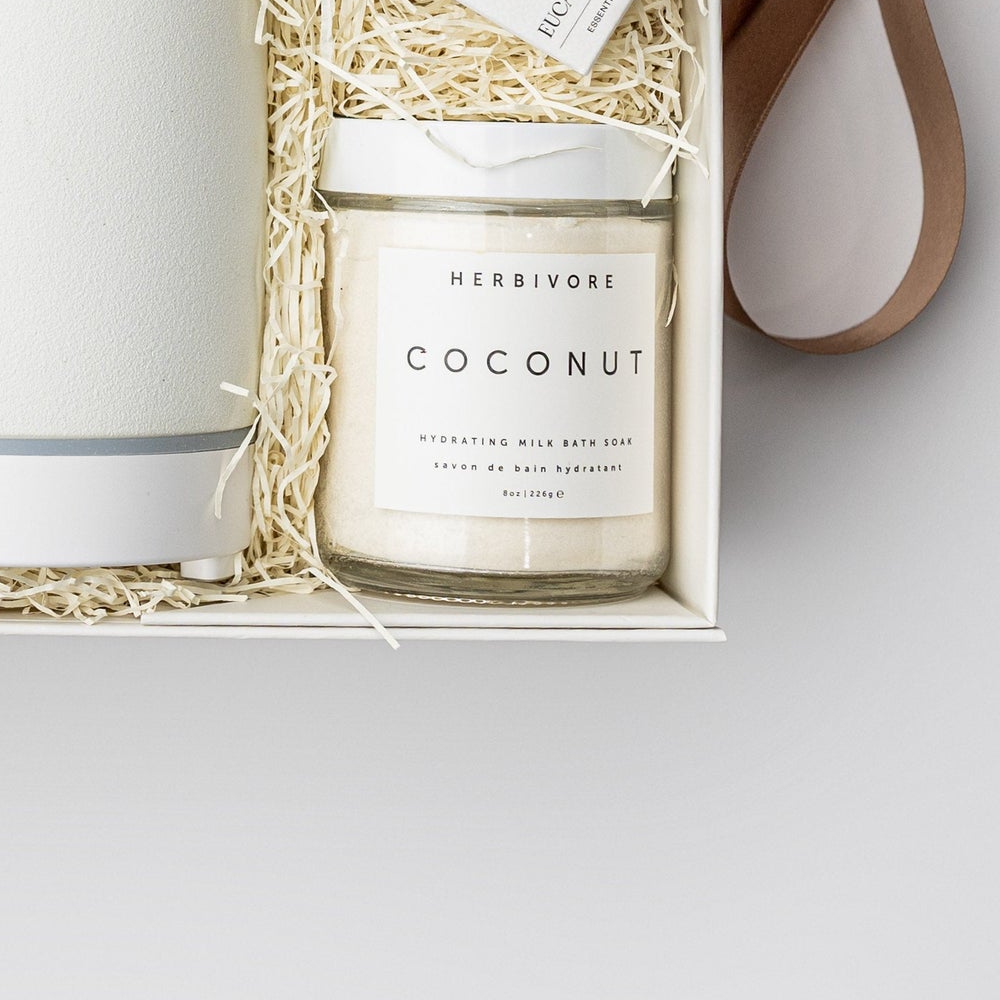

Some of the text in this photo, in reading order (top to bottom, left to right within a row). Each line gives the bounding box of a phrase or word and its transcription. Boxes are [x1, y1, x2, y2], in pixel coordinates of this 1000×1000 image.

[450, 271, 614, 289] HERBIVORE
[406, 345, 643, 377] COCONUT
[419, 433, 633, 448] HYDRATING MILK BATH SOAK
[434, 461, 623, 475] savon de bain hydratant
